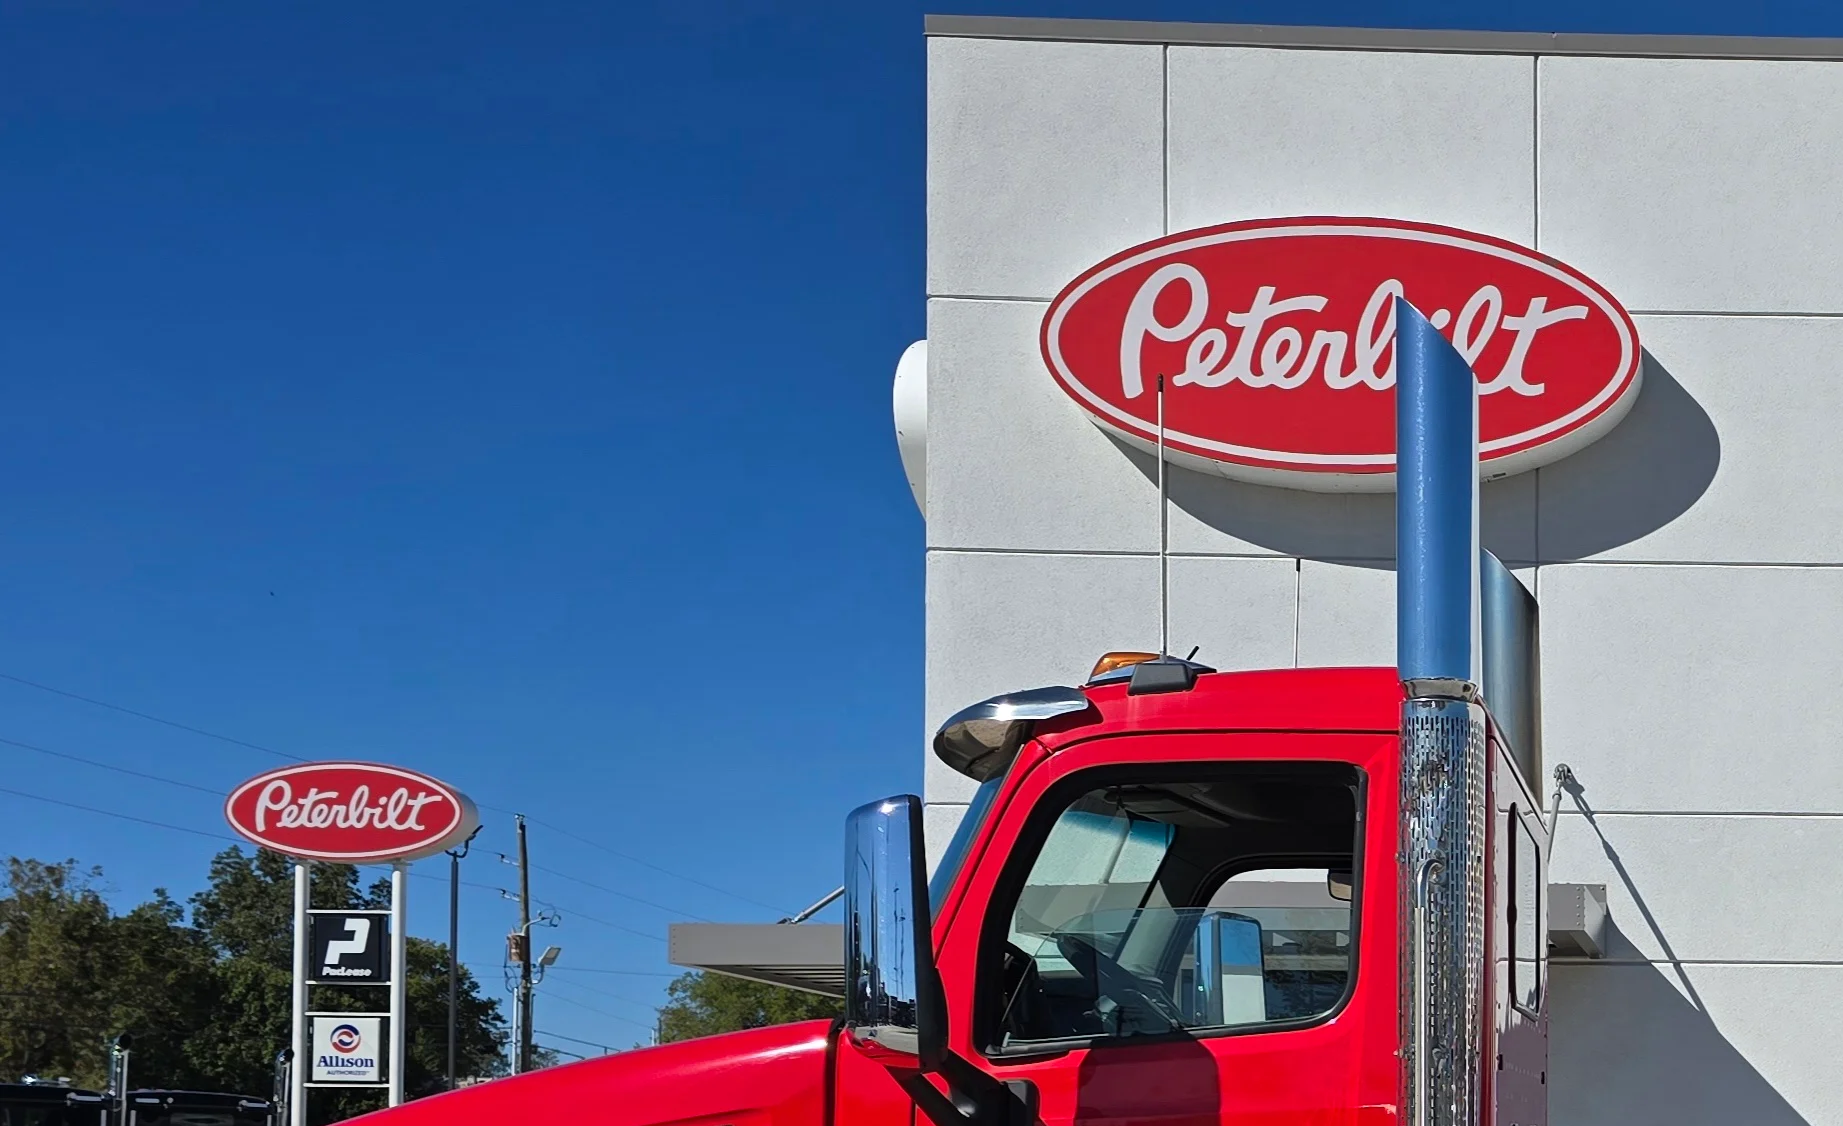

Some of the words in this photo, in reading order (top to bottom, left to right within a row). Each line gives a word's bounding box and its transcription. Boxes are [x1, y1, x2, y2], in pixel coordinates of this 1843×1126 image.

[1121, 261, 1589, 399] Peterblt
[255, 779, 443, 833] Peterbilt
[316, 1055, 374, 1068] Allison
